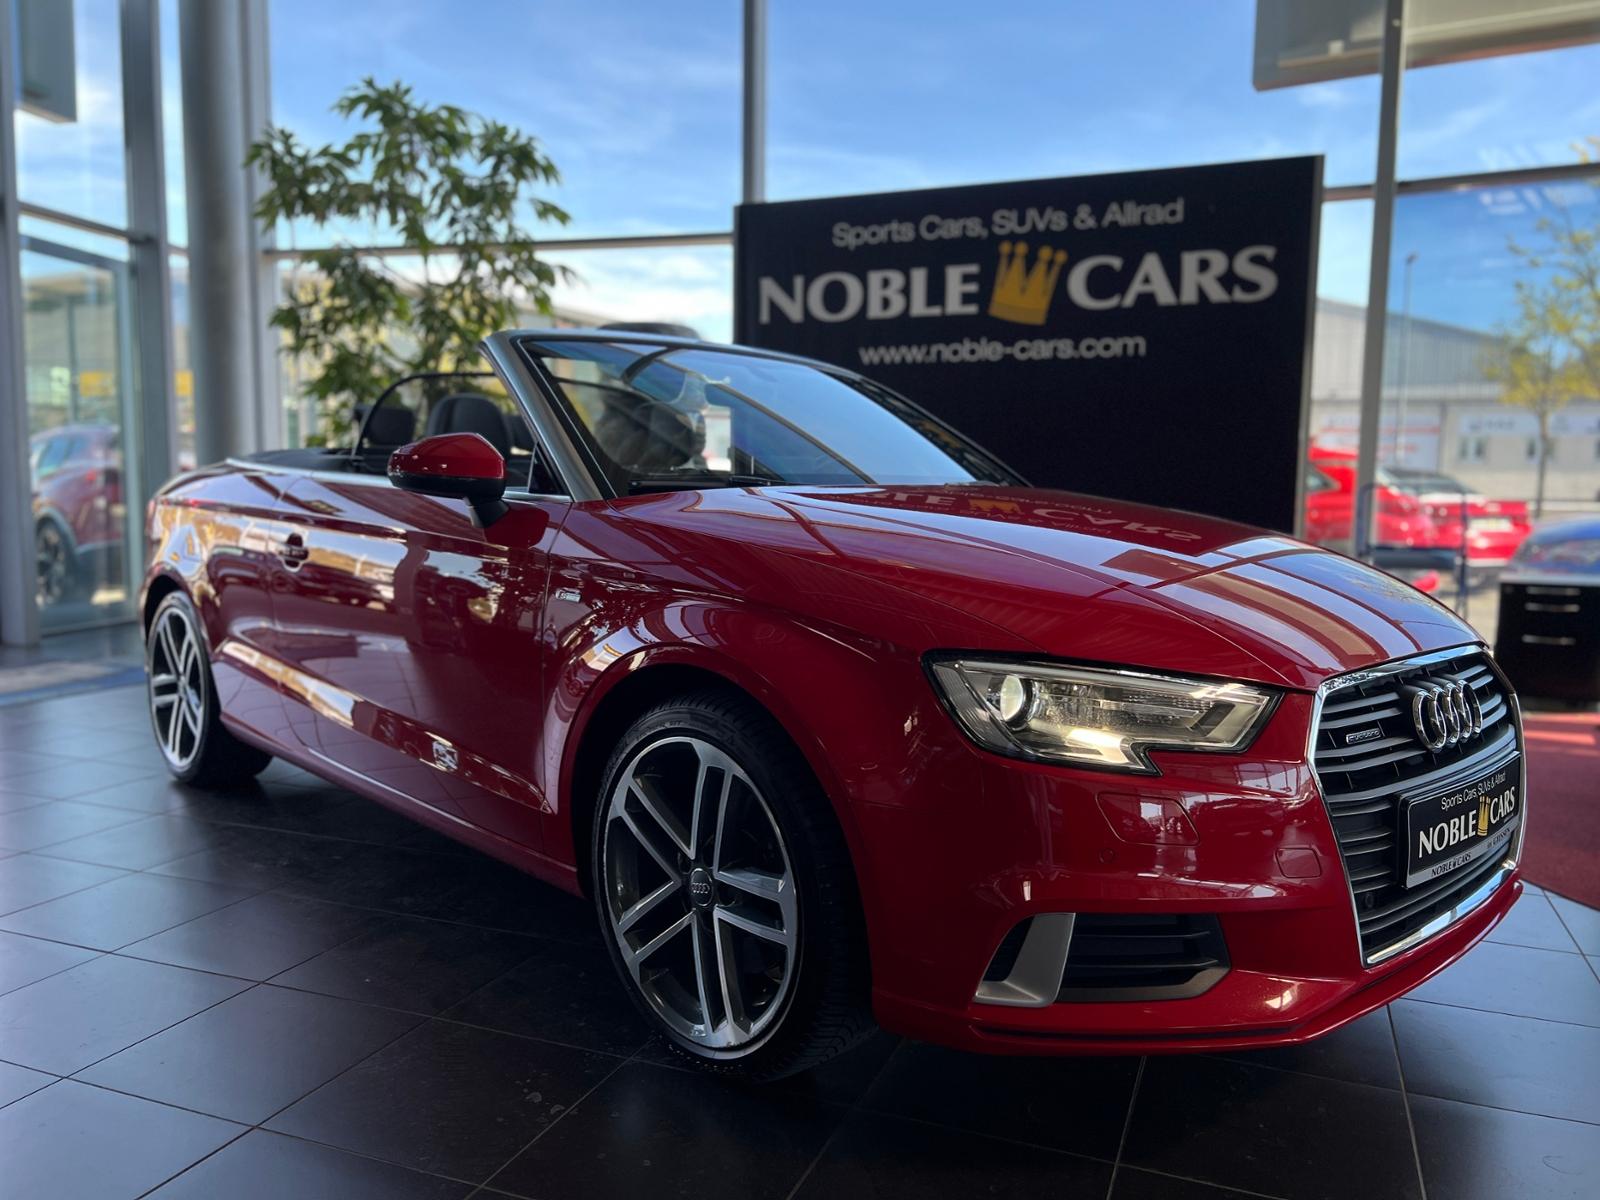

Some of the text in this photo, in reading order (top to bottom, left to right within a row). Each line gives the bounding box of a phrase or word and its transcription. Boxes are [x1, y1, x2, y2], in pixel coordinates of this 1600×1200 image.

[832, 196, 1185, 251] Sports Cars, SUVs & Allrad
[758, 245, 1279, 325] NOBLE CARS
[859, 333, 1147, 367] www.noble-cars.com
[1418, 809, 1477, 859] NOBLE
[1490, 786, 1515, 824] CARS
[1441, 794, 1463, 812] Sports
[1431, 861, 1452, 877] NOBLE
